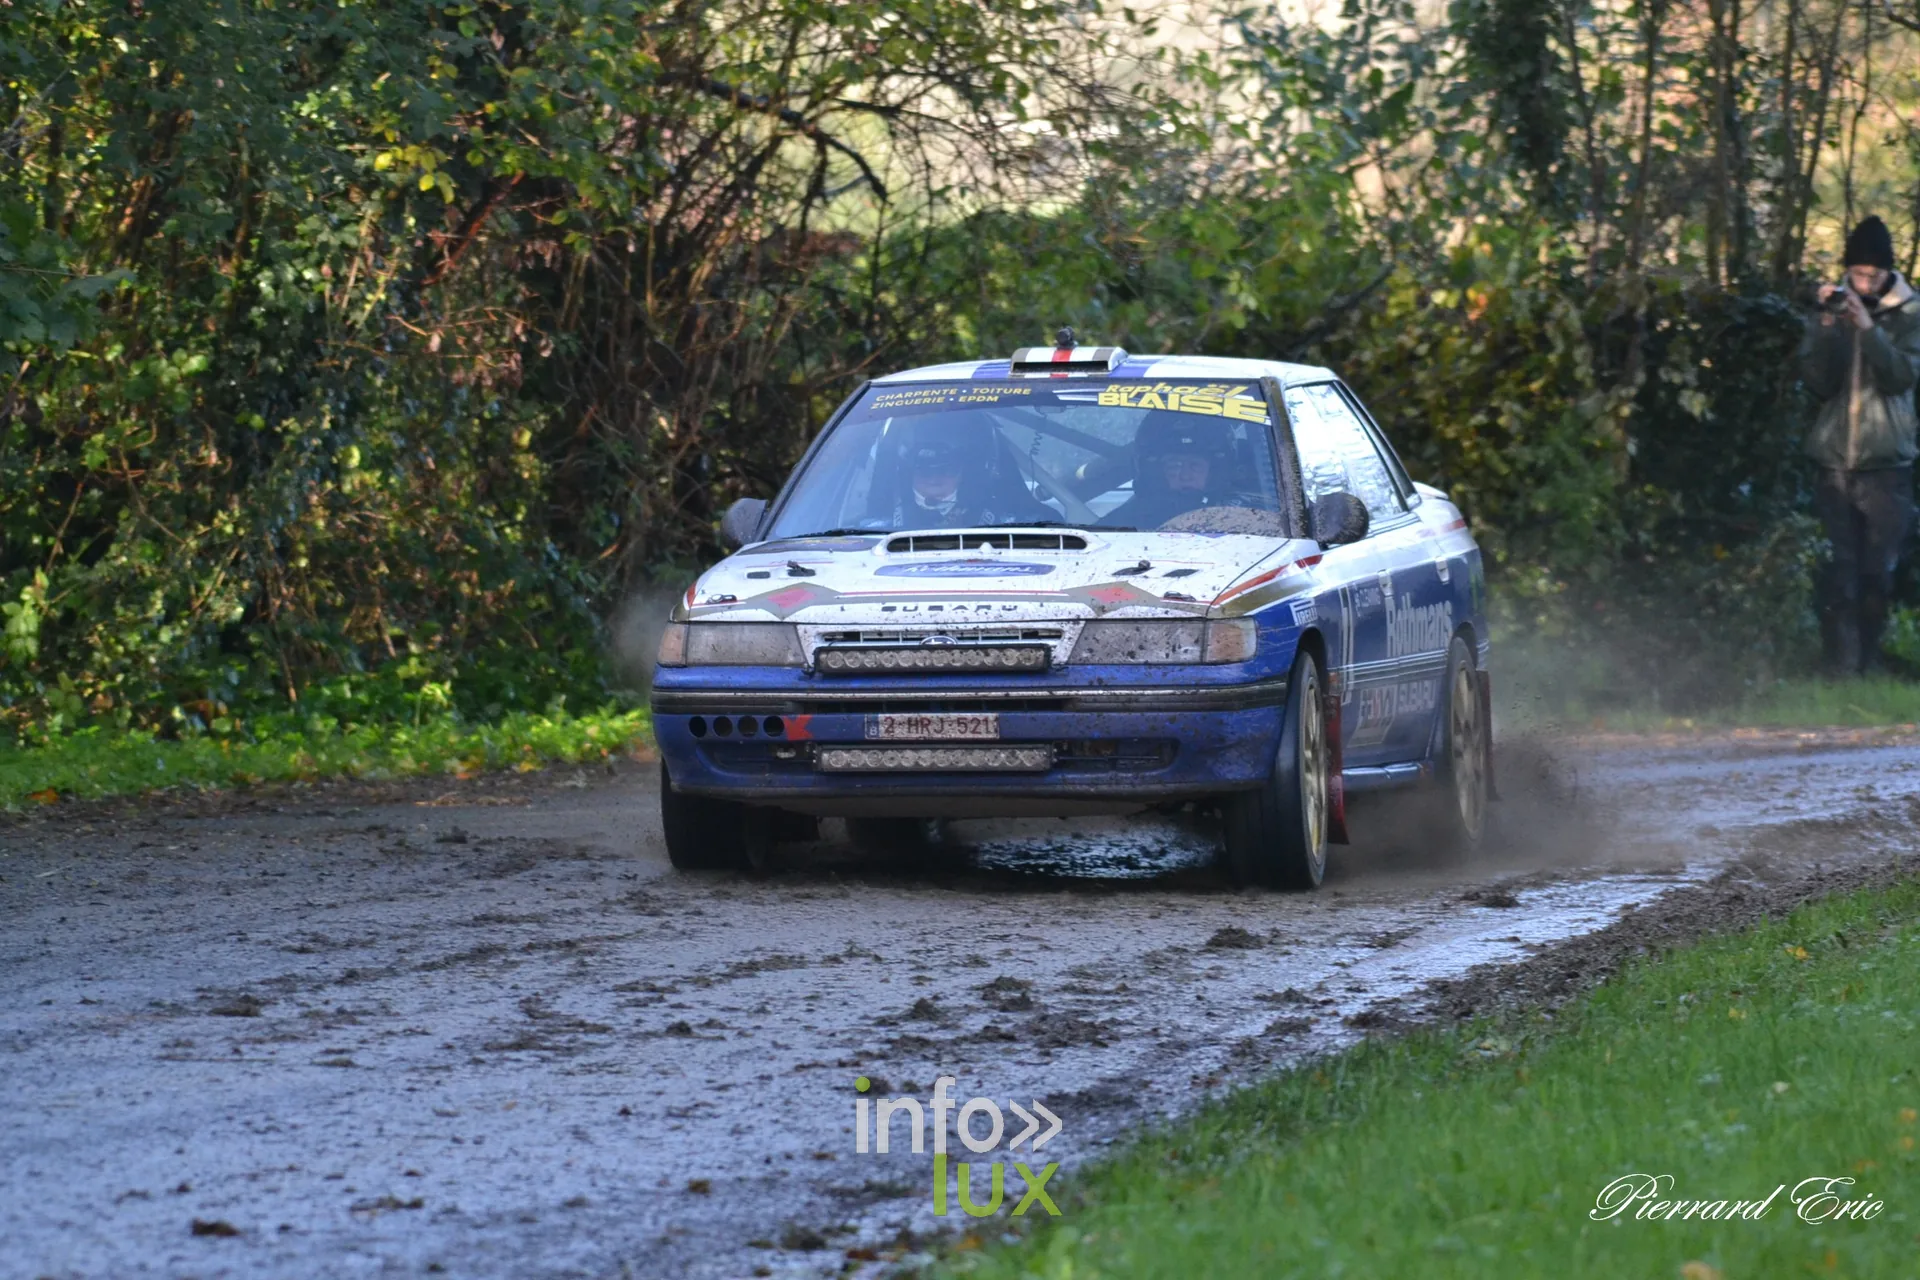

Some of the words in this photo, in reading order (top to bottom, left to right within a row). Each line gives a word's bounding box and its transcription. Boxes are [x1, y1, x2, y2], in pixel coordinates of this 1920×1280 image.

[876, 388, 958, 402] CHARPENTE
[972, 387, 1032, 395] TOITURE
[1104, 382, 1249, 398] Raphaël
[871, 396, 945, 409] ZINGUERIE
[958, 395, 999, 403] EPDM
[1098, 392, 1268, 424] BLAISE
[1384, 592, 1453, 658] Rothmans
